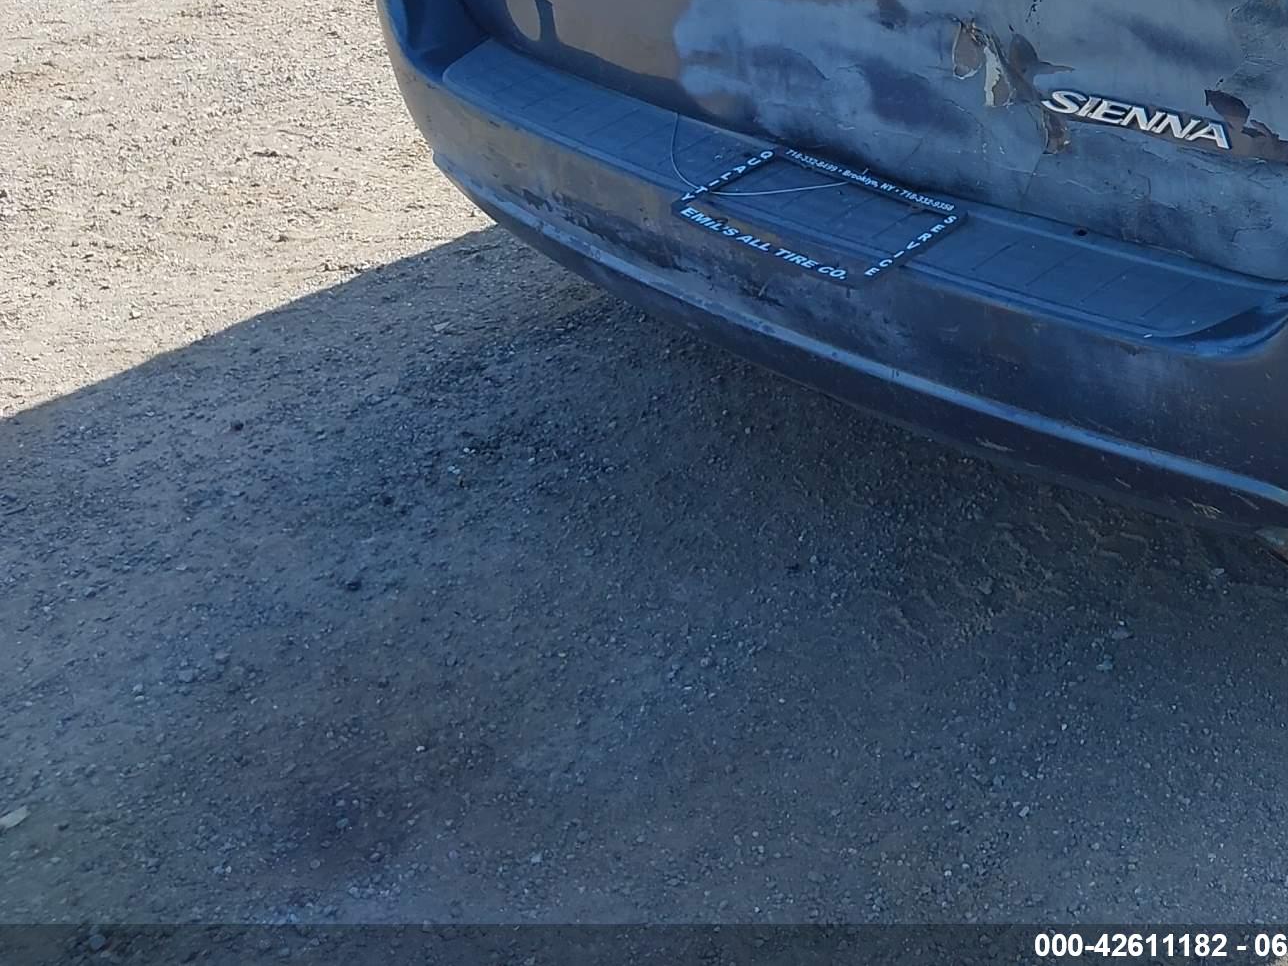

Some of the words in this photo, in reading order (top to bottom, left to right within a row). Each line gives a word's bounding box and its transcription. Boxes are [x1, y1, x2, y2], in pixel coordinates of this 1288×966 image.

[1042, 90, 1230, 150] SIENNA
[681, 150, 774, 201] QUALITY
[680, 206, 739, 237] EMIL'S
[735, 234, 769, 252] ALL
[774, 248, 819, 269] TIRE
[817, 265, 848, 280] CO.
[864, 215, 957, 276] SERVICE
